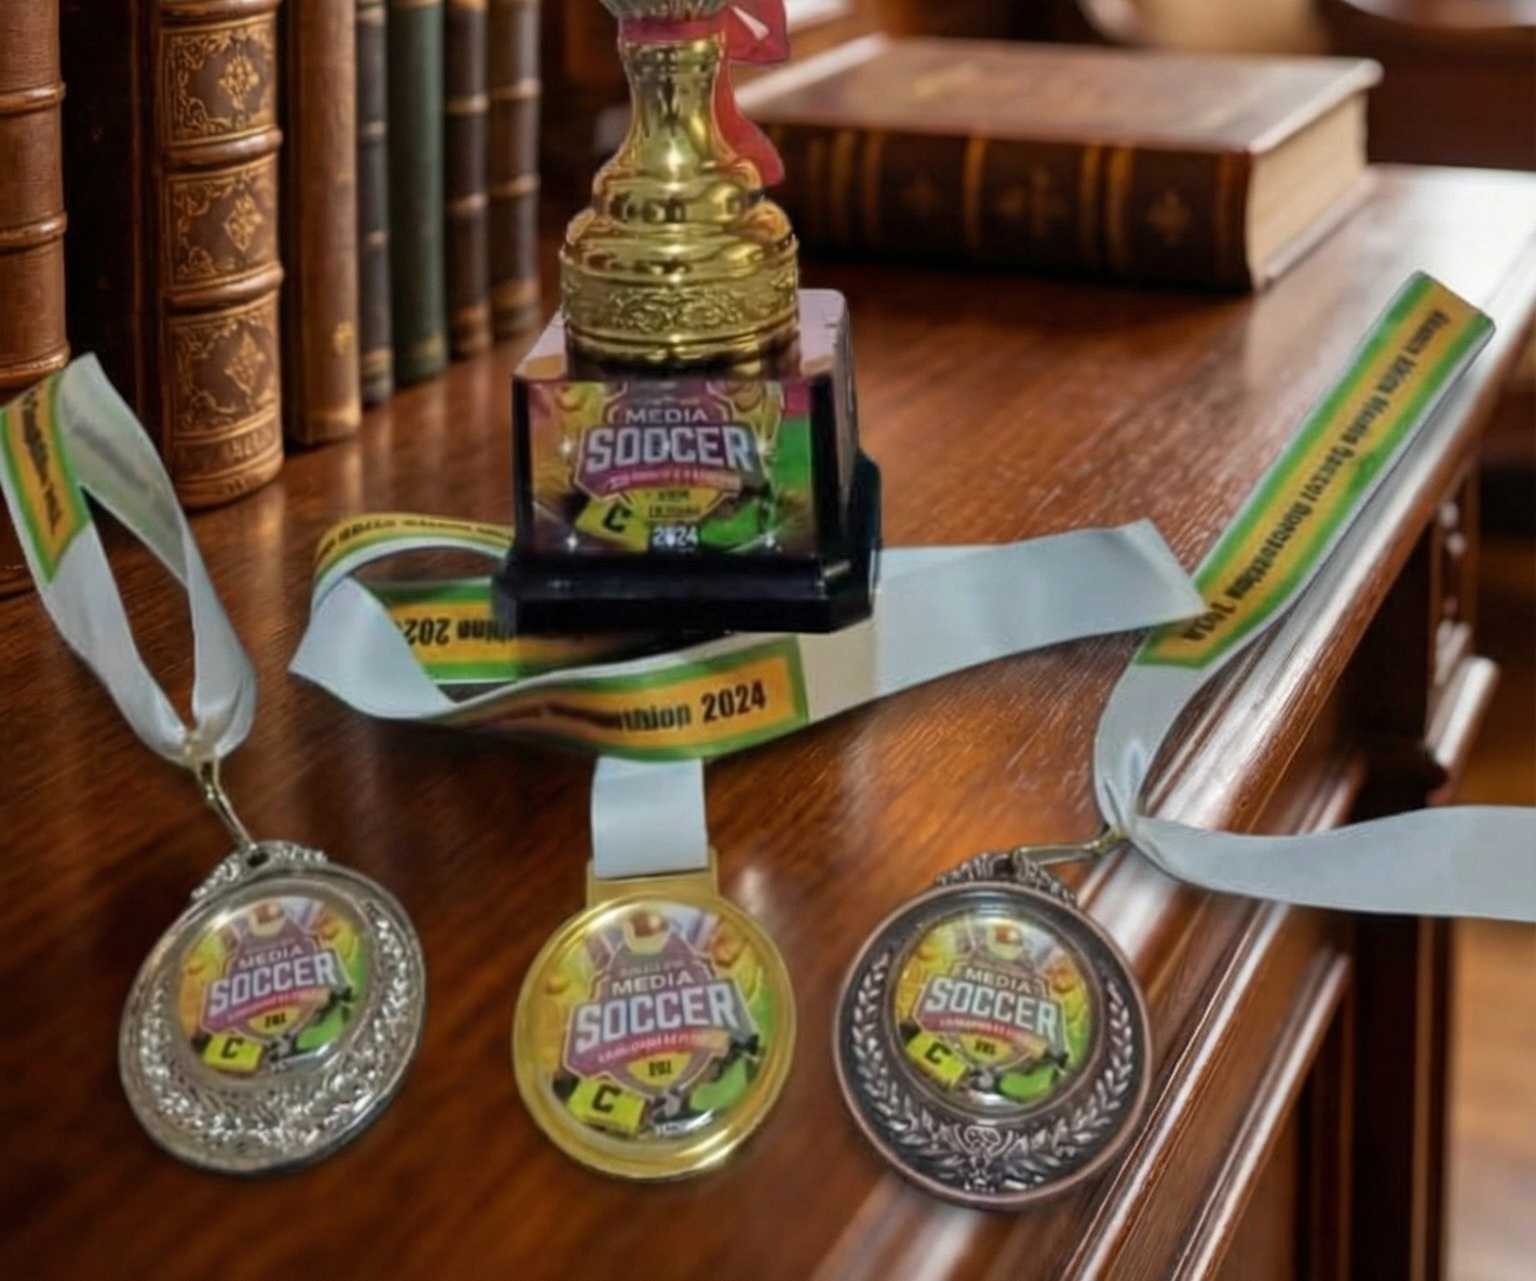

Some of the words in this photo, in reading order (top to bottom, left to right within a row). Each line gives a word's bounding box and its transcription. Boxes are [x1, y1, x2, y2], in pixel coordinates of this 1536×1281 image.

[626, 408, 708, 424] MEDIA
[402, 617, 451, 646] 202
[701, 680, 767, 723] 2024
[238, 944, 304, 967] MEDIA
[209, 950, 339, 1019] SOCCER
[611, 969, 695, 996] MEDIA
[965, 967, 1032, 994] MEDIA
[574, 982, 740, 1054] SOCCER
[923, 976, 1058, 1043] SOCCER
